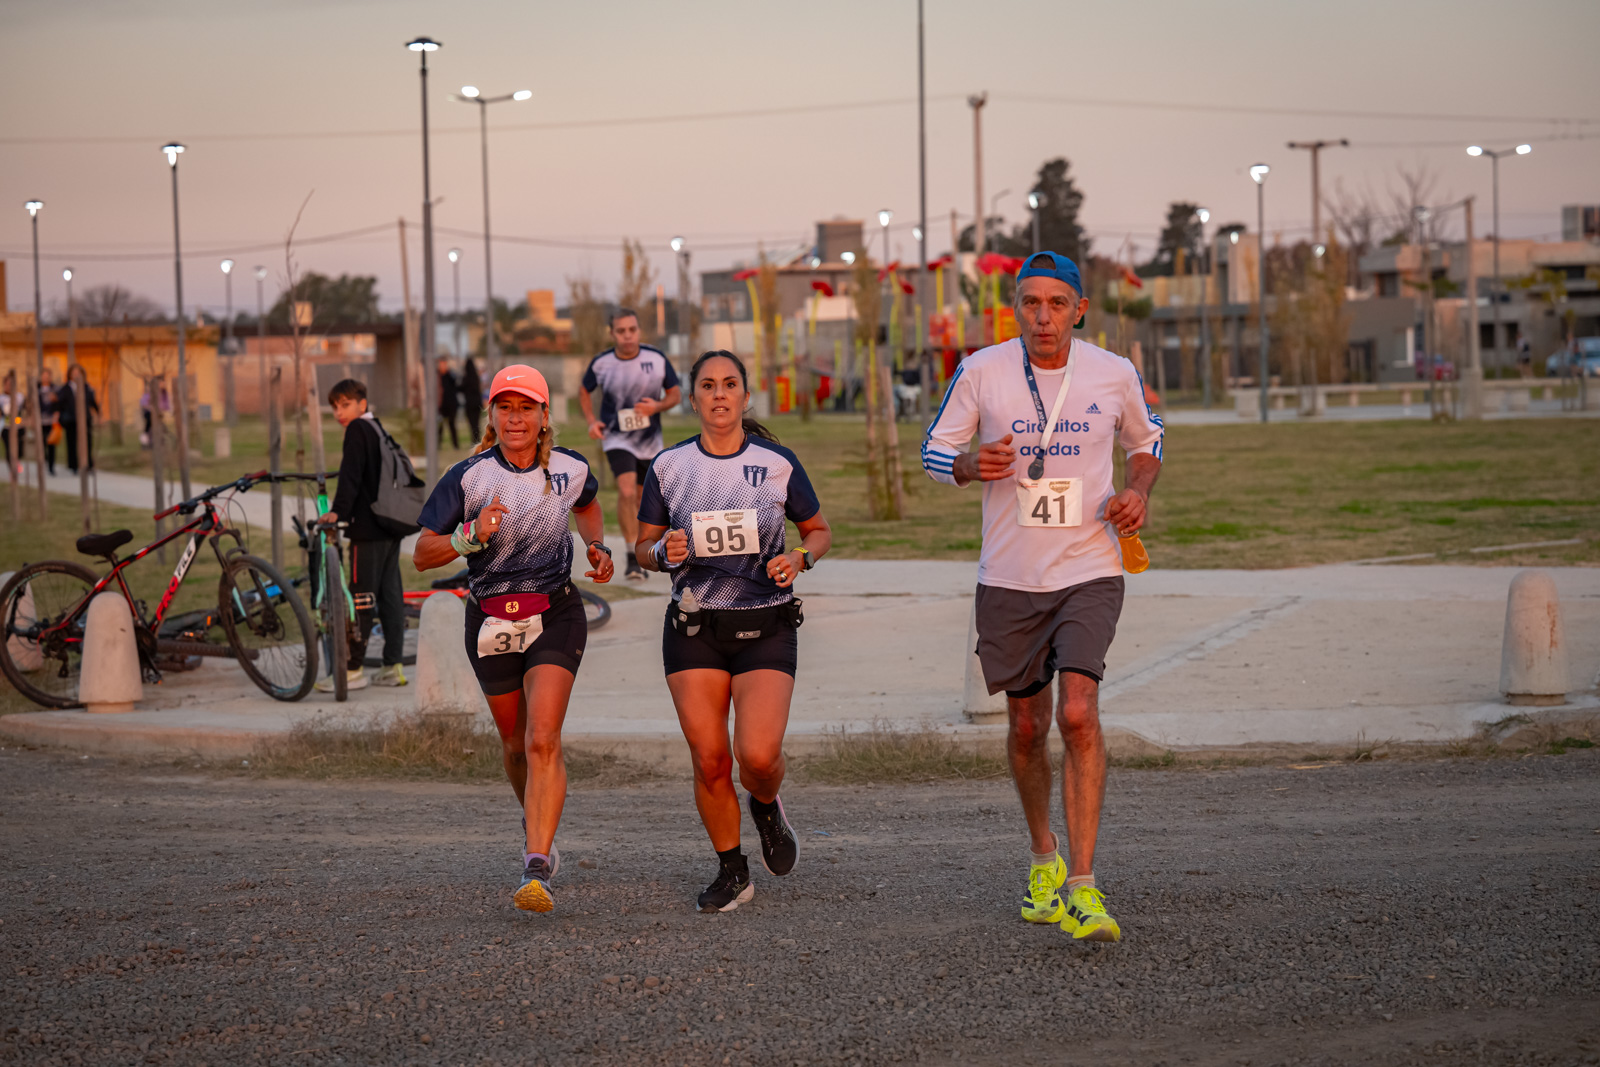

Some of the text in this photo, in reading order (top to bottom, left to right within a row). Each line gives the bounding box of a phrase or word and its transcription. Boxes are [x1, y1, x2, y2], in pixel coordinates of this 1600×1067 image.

[747, 466, 764, 474] SFC
[1031, 495, 1066, 524] 41
[705, 524, 746, 554] 95
[494, 631, 527, 653] 31
